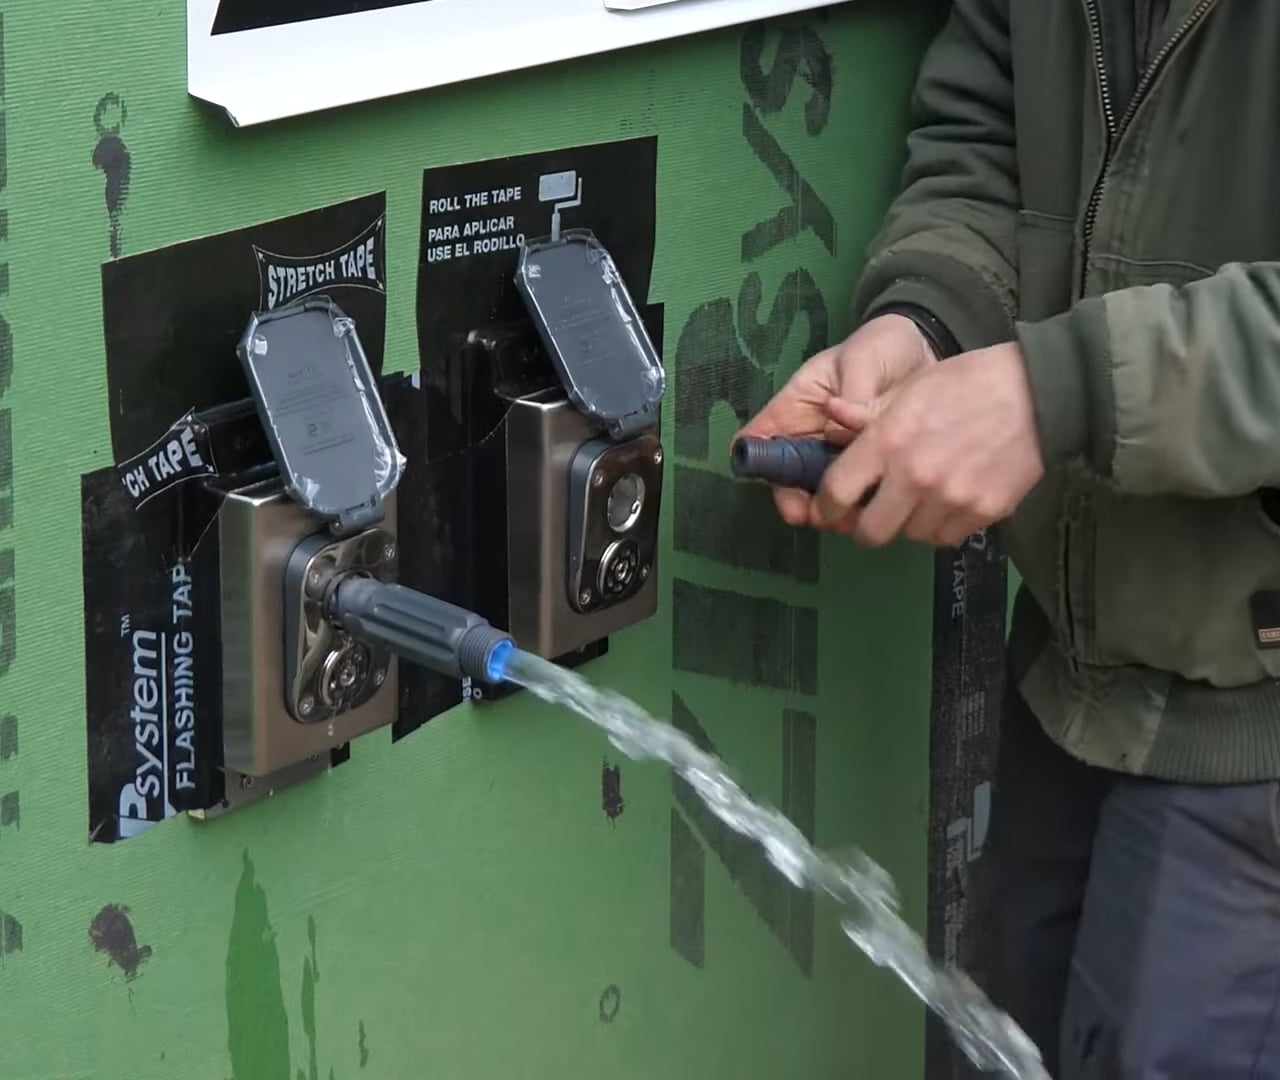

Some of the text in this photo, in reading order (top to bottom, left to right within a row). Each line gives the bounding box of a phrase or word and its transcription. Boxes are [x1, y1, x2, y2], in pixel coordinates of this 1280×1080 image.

[429, 186, 522, 214] ROLL THE TAPE
[427, 233, 525, 262] USE EL RODILLO
[428, 215, 515, 243] PARA APLICAR
[267, 236, 377, 311] STRETCH TAPE
[147, 425, 204, 481] TAPE
[951, 560, 964, 619] TAPE
[172, 561, 196, 791] FLASHING TAP
